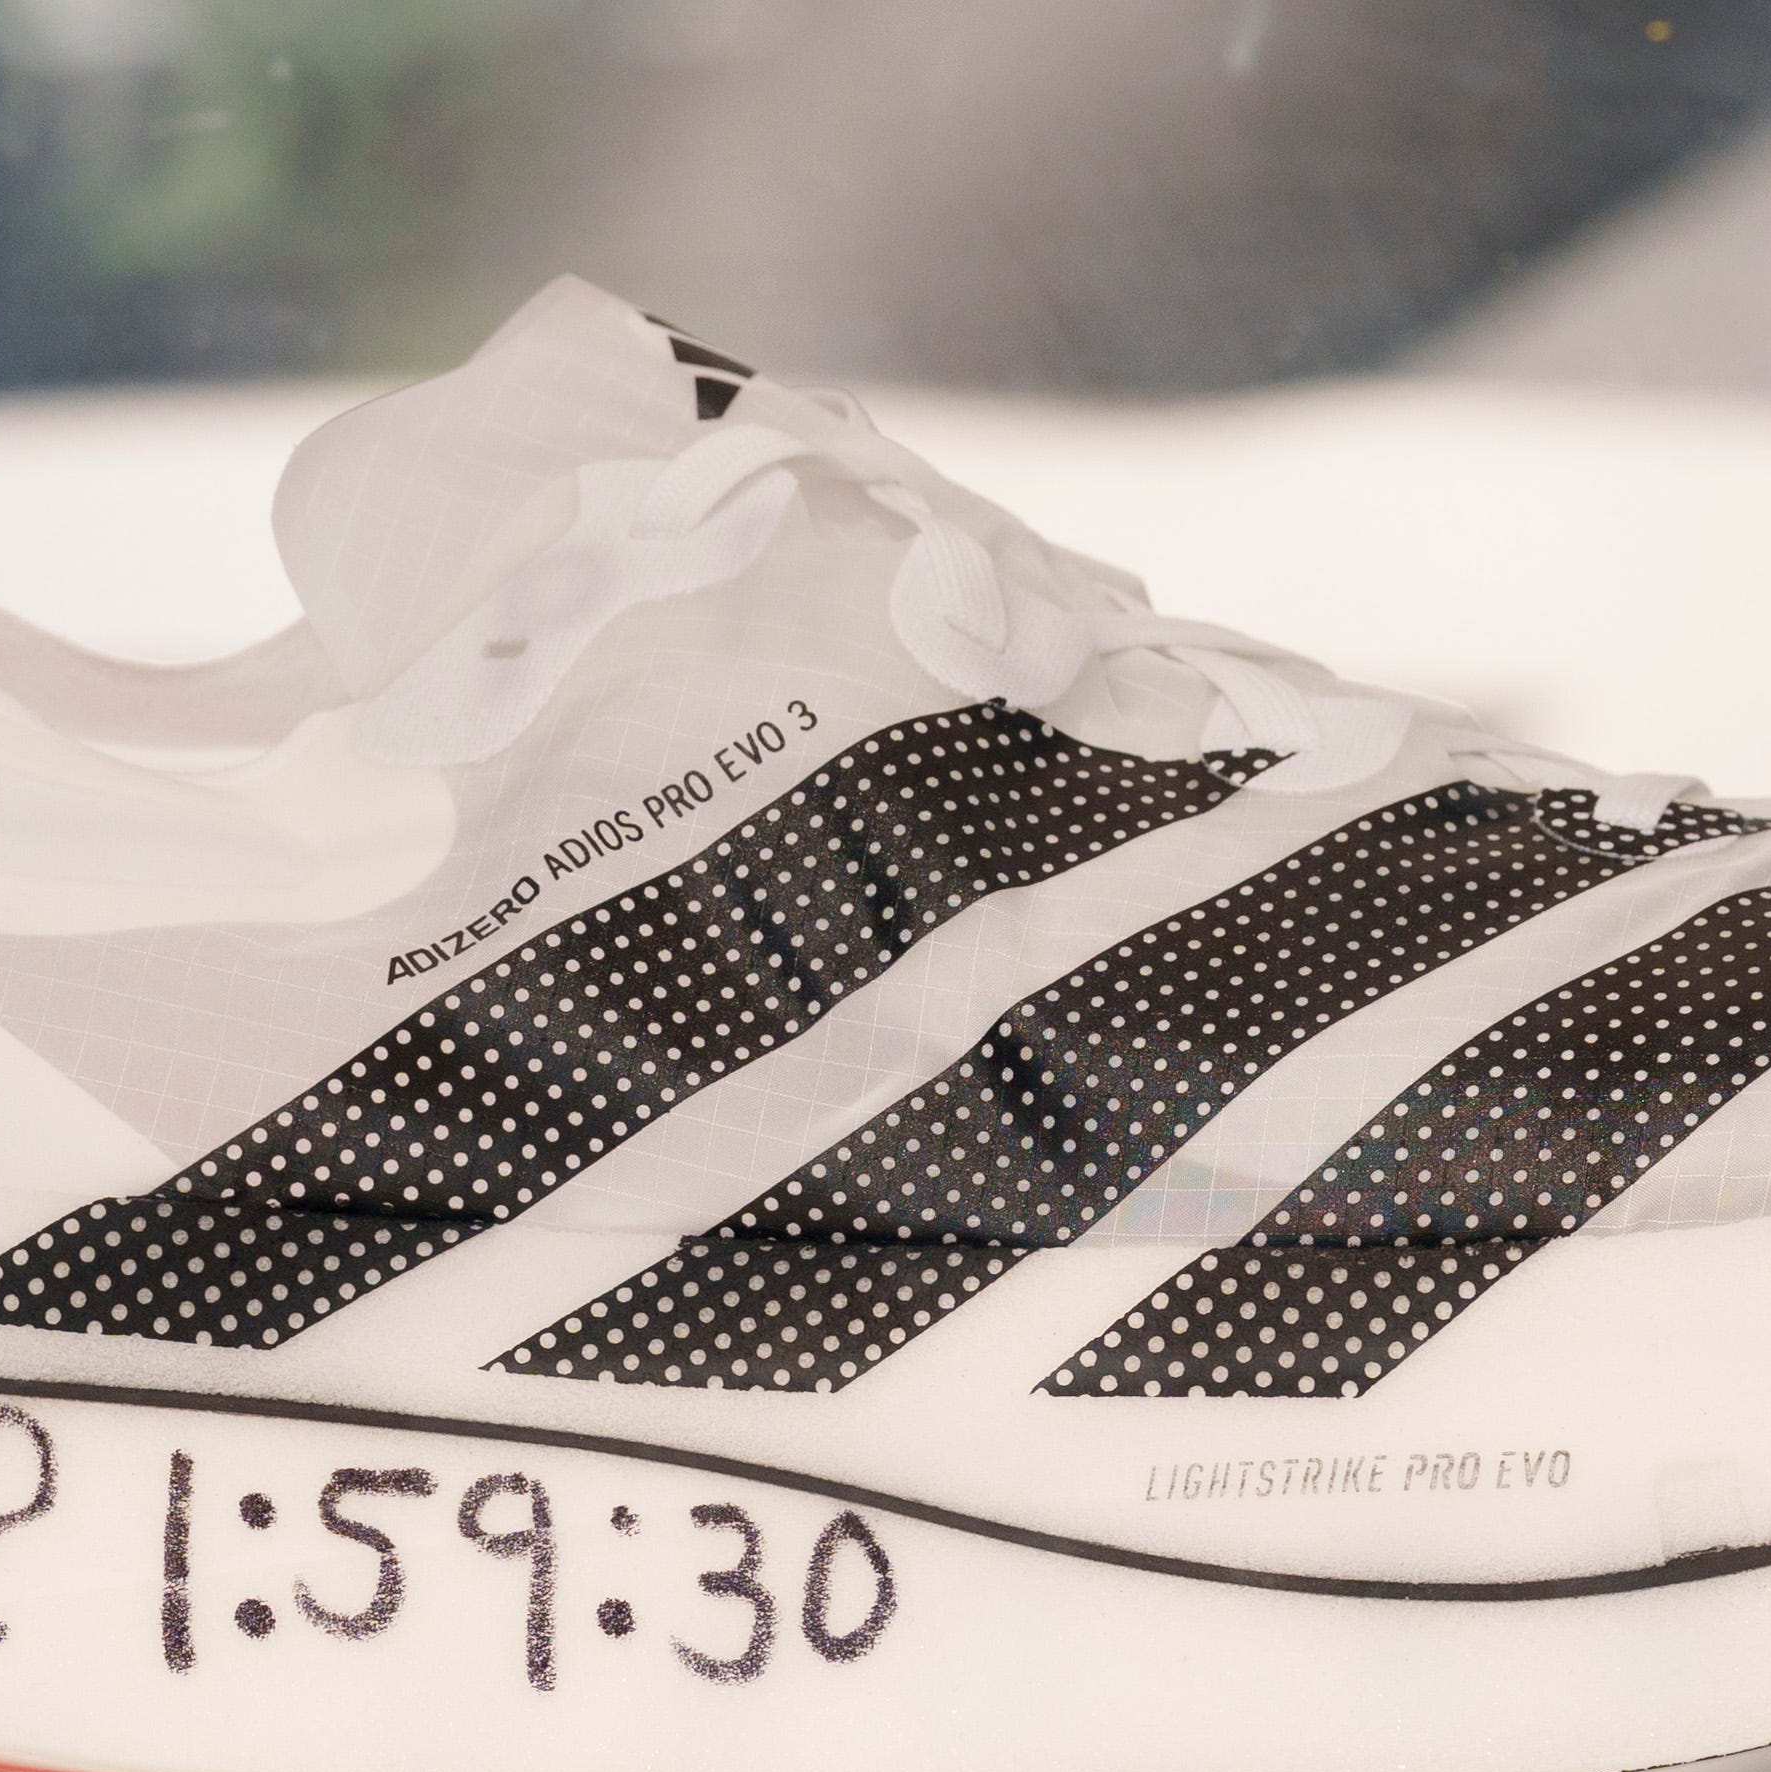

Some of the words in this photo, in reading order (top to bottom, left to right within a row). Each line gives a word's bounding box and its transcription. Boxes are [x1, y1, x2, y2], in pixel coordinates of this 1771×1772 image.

[386, 875, 541, 986] ADIZERO
[542, 810, 644, 881] ADIOS
[642, 770, 713, 829] PRO
[714, 721, 786, 783] EVO
[786, 700, 818, 731] 3
[163, 1450, 898, 1690] 1:59:30
[1145, 1455, 1389, 1502] LIGHTSTRIKE
[1402, 1453, 1481, 1493] PRO
[1495, 1449, 1572, 1490] EVO
